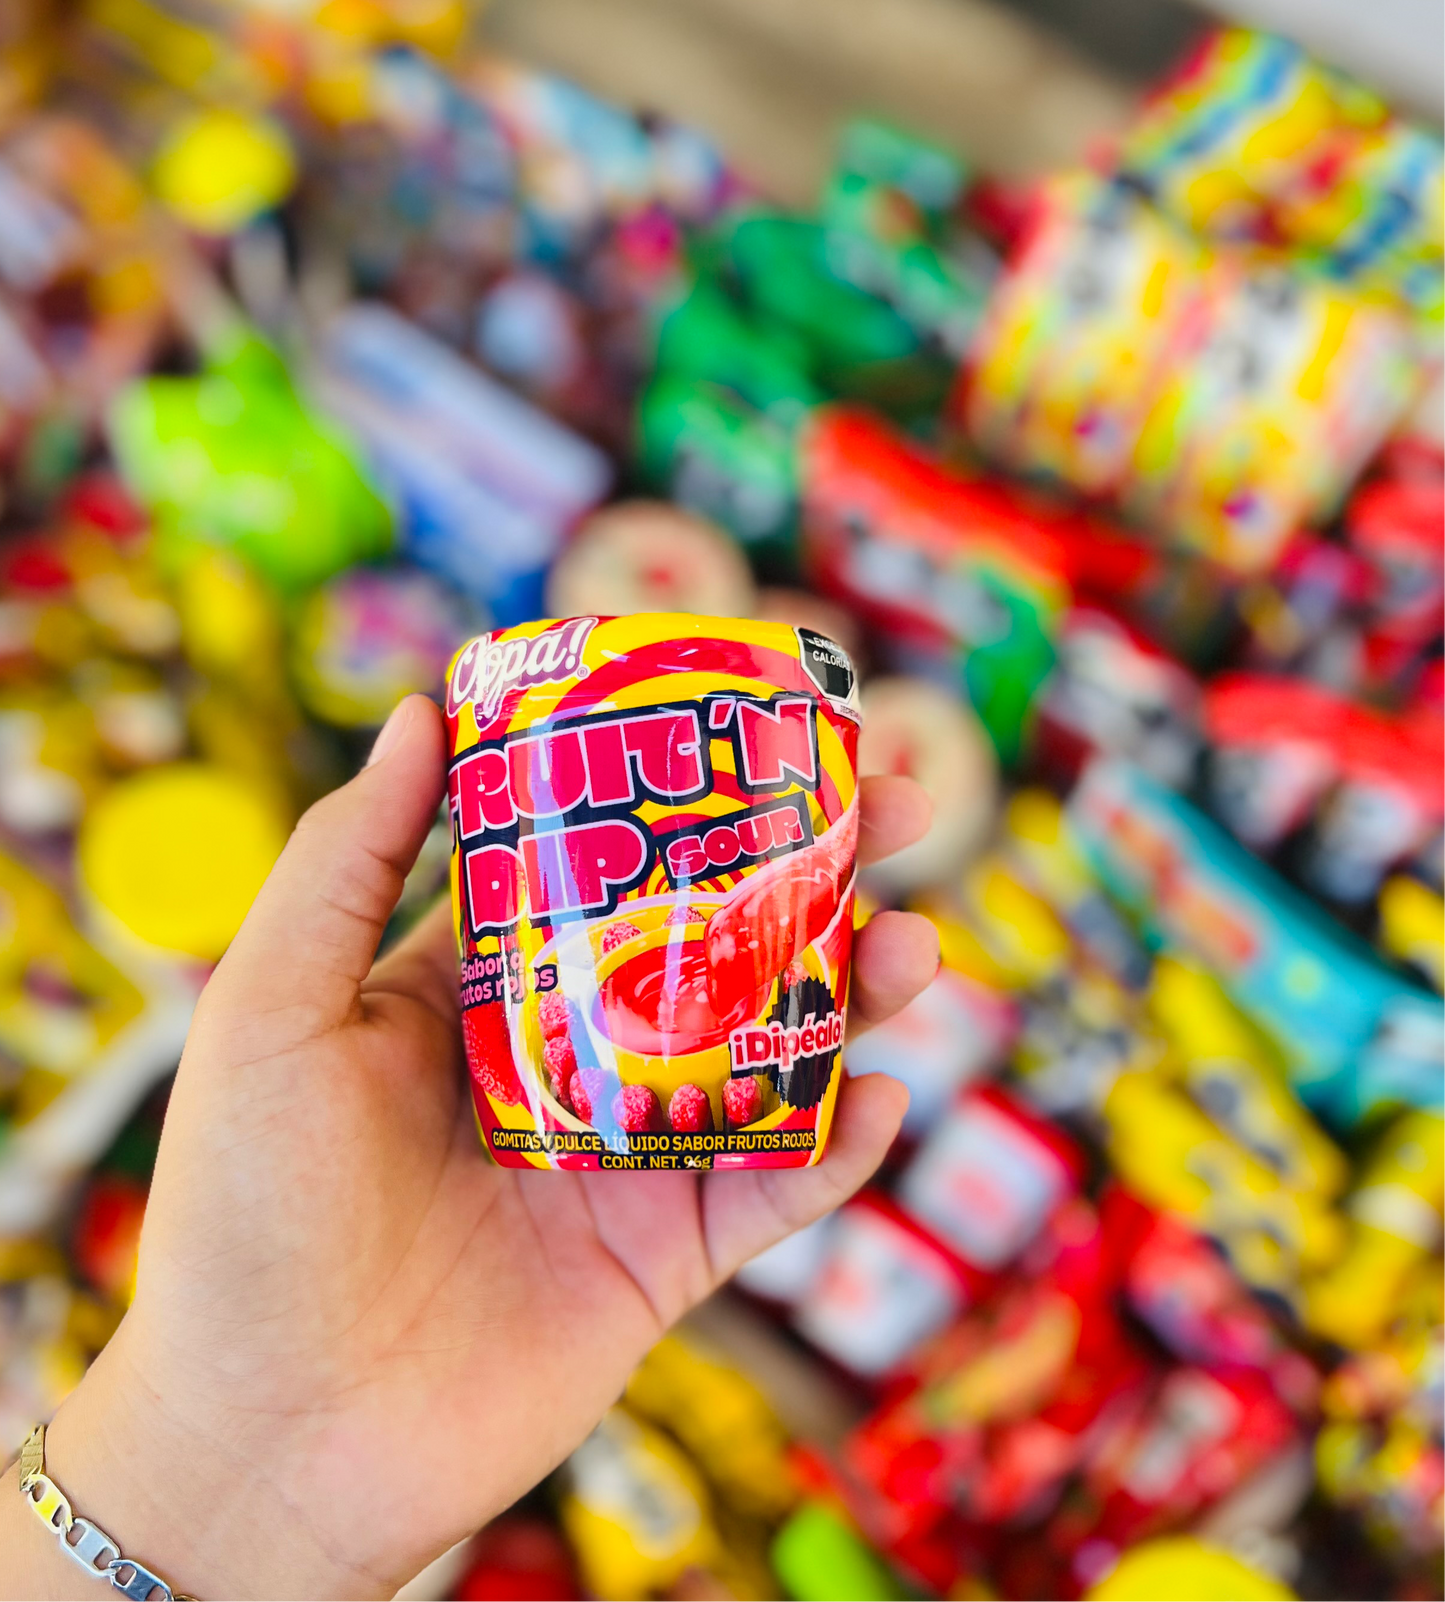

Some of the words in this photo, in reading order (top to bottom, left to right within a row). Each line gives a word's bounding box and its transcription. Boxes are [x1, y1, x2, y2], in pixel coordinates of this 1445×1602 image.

[666, 806, 804, 878] SOUR
[466, 819, 648, 934] DIP
[493, 1131, 541, 1150] GOMITAS
[555, 1135, 601, 1151] DULCE
[604, 1132, 670, 1154] LÍQUIDO
[672, 1135, 725, 1151] SABOR
[728, 1135, 780, 1150] FRUTOS
[782, 1132, 815, 1149] ROJOS.
[602, 1155, 647, 1169] CONT.
[650, 1155, 681, 1168] NET.
